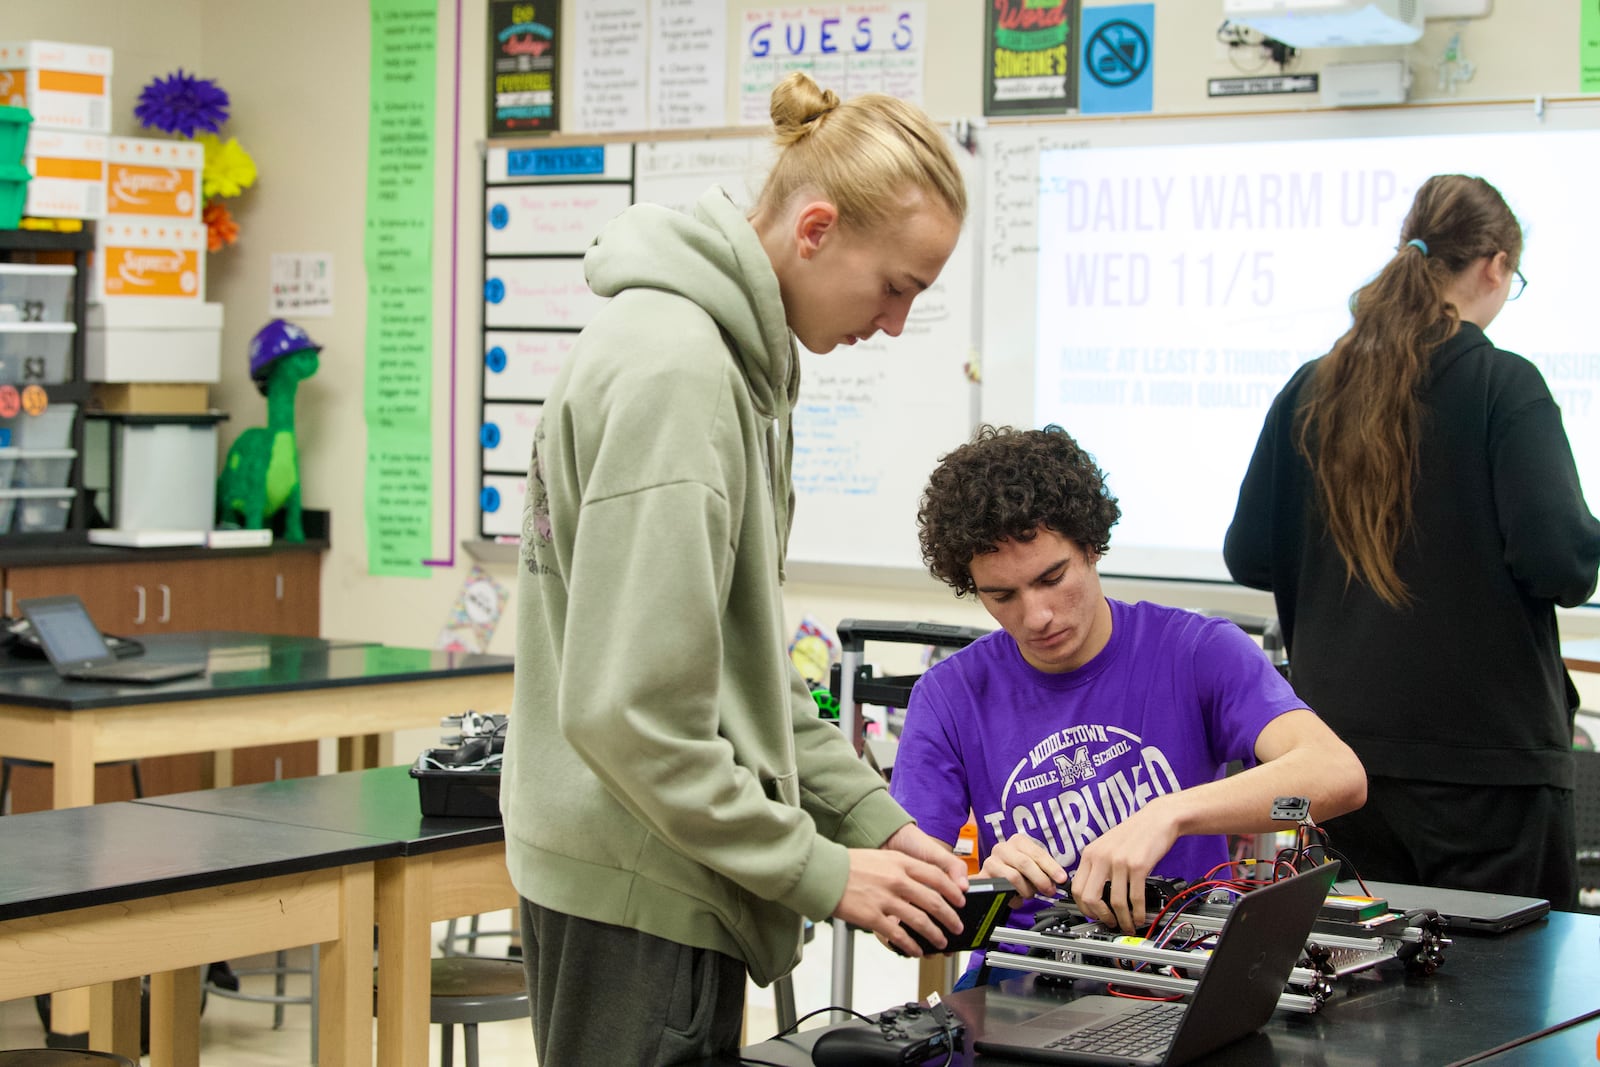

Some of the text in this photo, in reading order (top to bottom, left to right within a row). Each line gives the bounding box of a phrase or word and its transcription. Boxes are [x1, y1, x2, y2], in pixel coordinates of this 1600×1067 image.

[750, 12, 912, 57] GUESS
[994, 44, 1067, 78] SOMEONE'S
[536, 150, 603, 171] PHYSICS
[1066, 174, 1175, 232] DAILY
[1190, 171, 1323, 230] WARM
[1064, 250, 1275, 306] WED 11/5
[1062, 347, 1111, 371] NAME
[1116, 347, 1136, 372] AT
[1143, 348, 1200, 373] LEAST
[1203, 348, 1217, 374] 3
[1223, 349, 1292, 375] THINGS
[1059, 379, 1127, 405] SUBMIT
[1131, 380, 1144, 406] A
[1150, 381, 1192, 406] HIGH
[1198, 382, 1275, 408] QUALITY
[1014, 740, 1131, 794] MIDDLE SCHOOL
[1029, 724, 1109, 769] MIDDLETOWN
